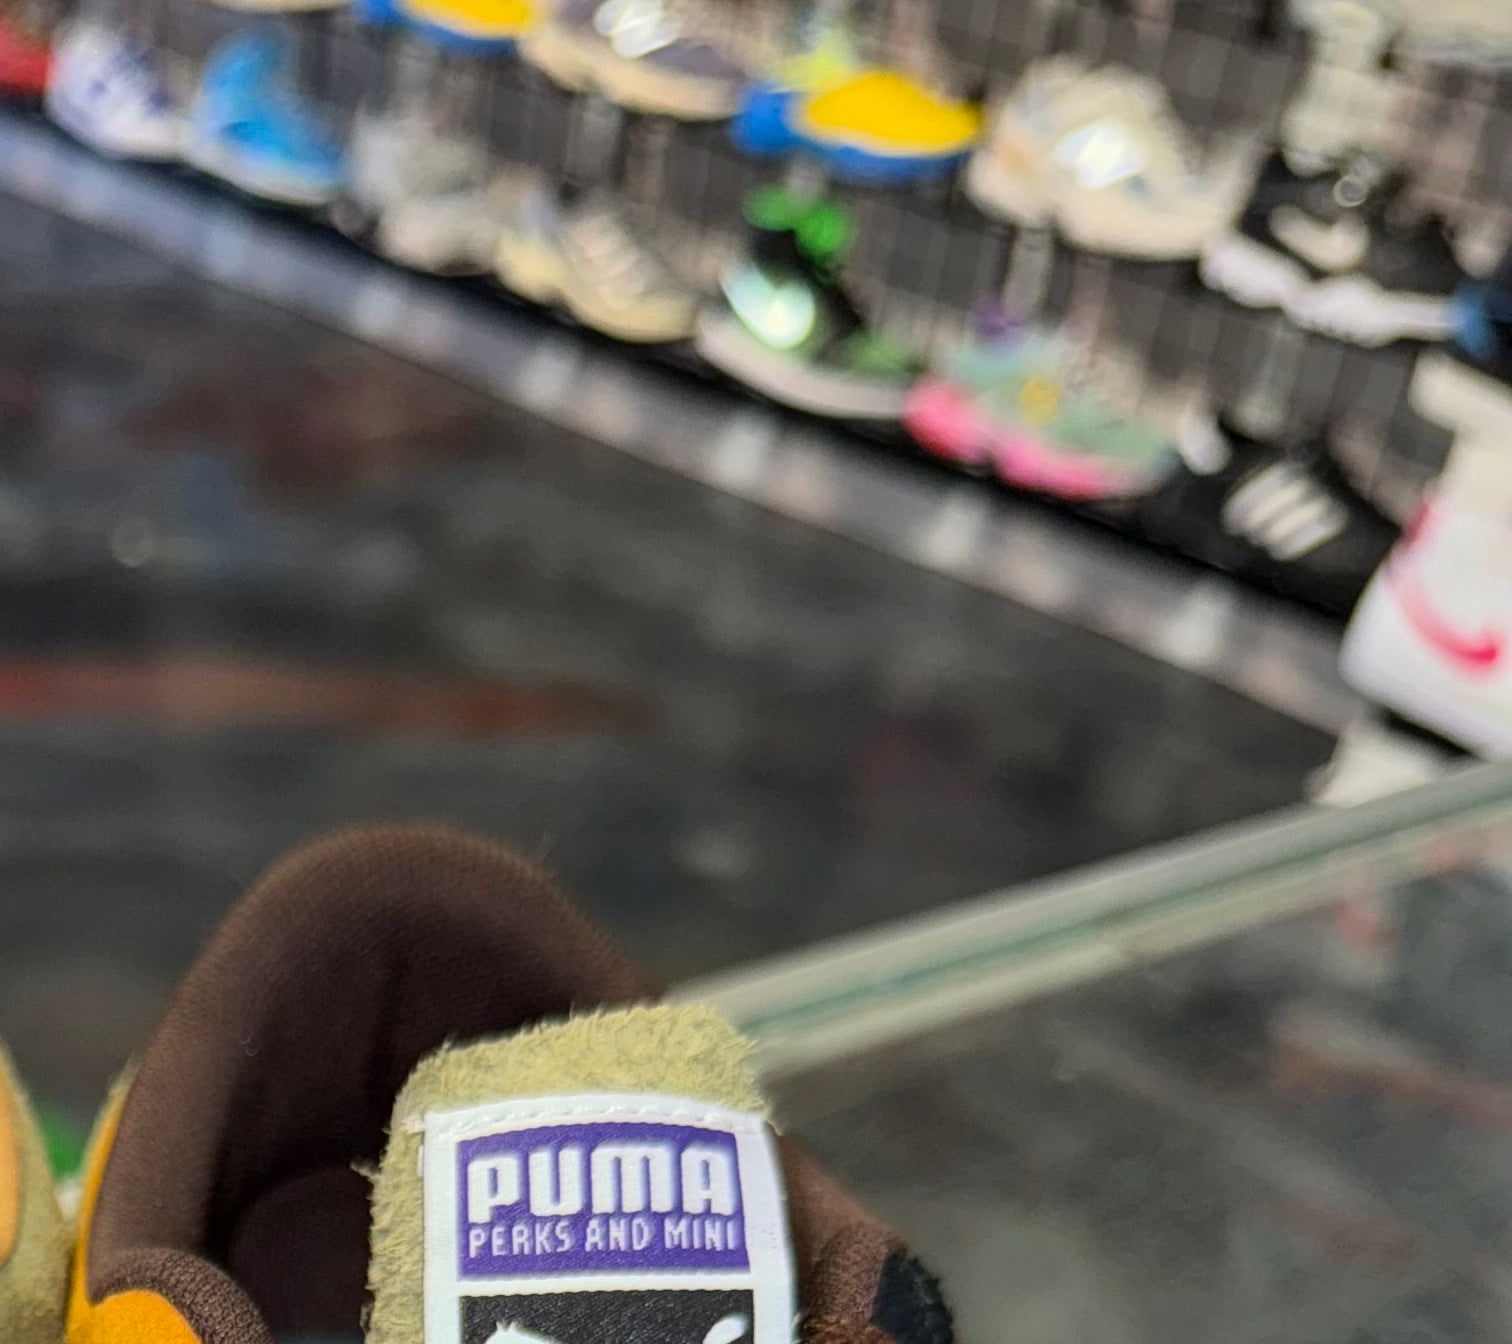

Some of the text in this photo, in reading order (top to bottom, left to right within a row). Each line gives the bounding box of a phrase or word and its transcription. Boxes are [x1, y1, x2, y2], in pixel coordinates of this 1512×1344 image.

[467, 1144, 735, 1223] PUMA
[468, 1220, 737, 1258] PERKS AND MINI
